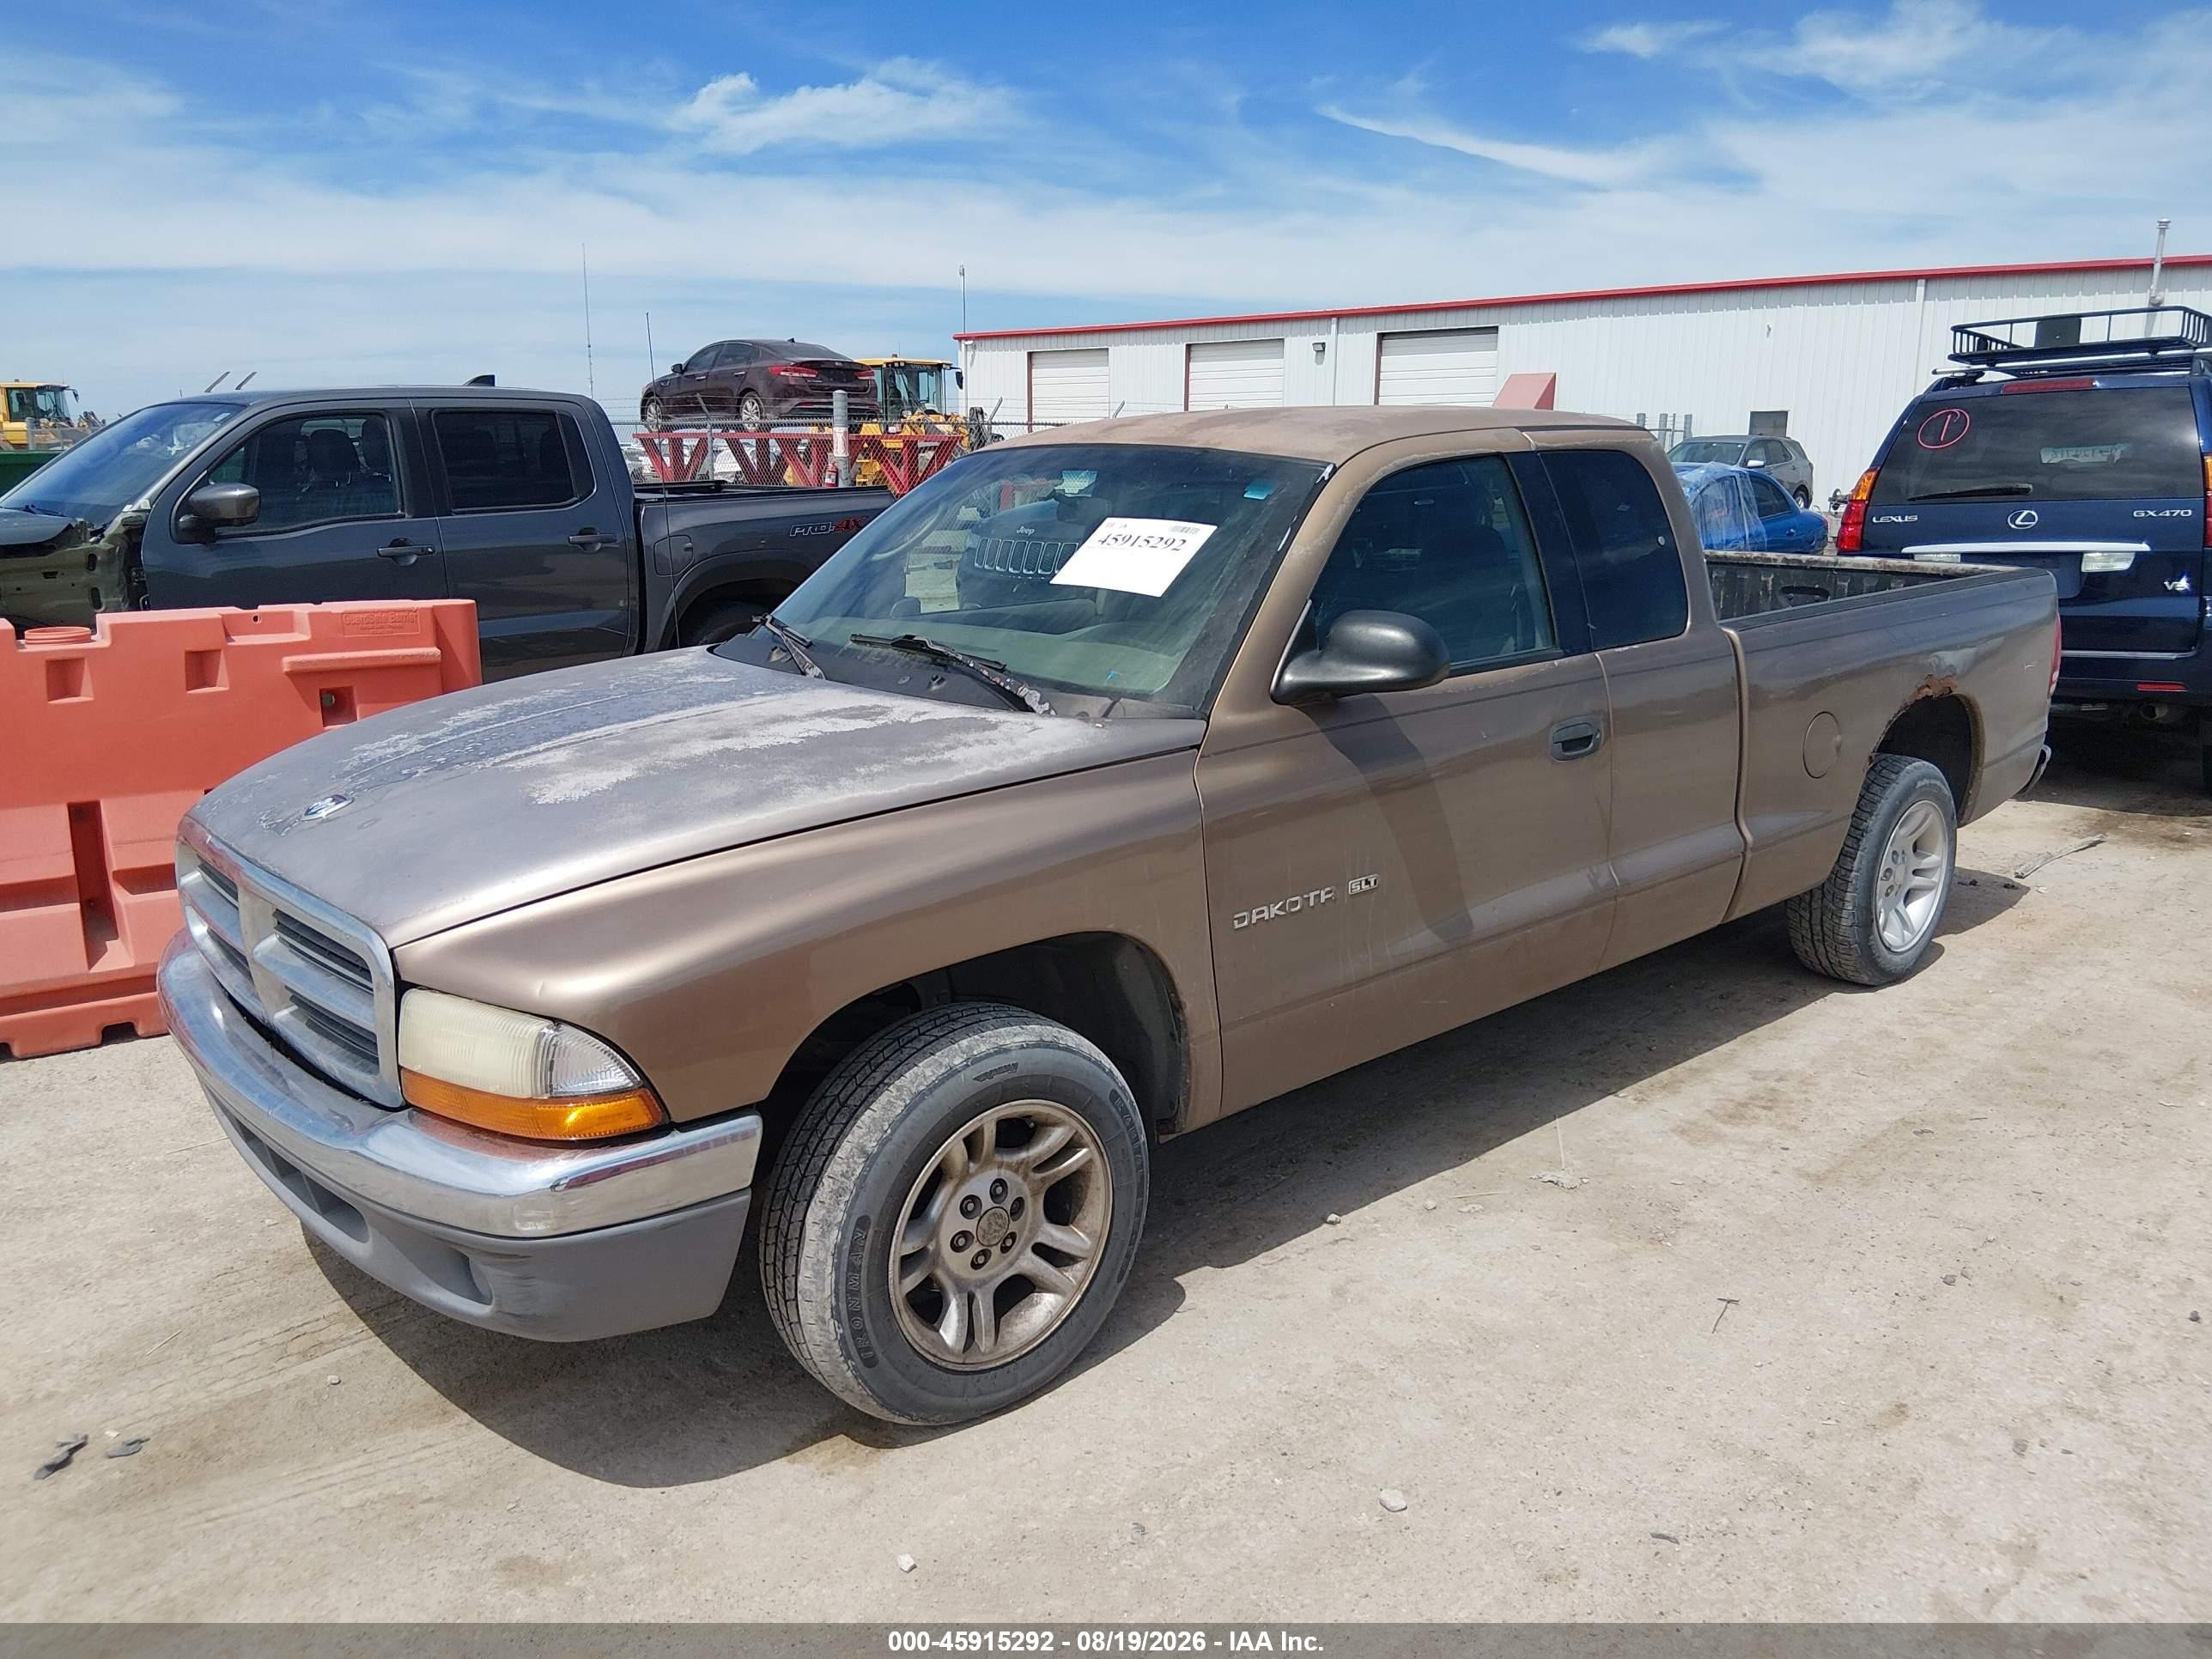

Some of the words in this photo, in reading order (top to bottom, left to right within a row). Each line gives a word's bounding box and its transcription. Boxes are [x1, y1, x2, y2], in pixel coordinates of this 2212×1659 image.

[1872, 514, 1918, 524] LEXUS
[1016, 526, 1035, 536] Jeep
[1097, 532, 1187, 551] 45915292
[1350, 875, 1378, 893] SLT
[1232, 885, 1337, 930] DAKOTA
[848, 1228, 874, 1360] IRONMAN
